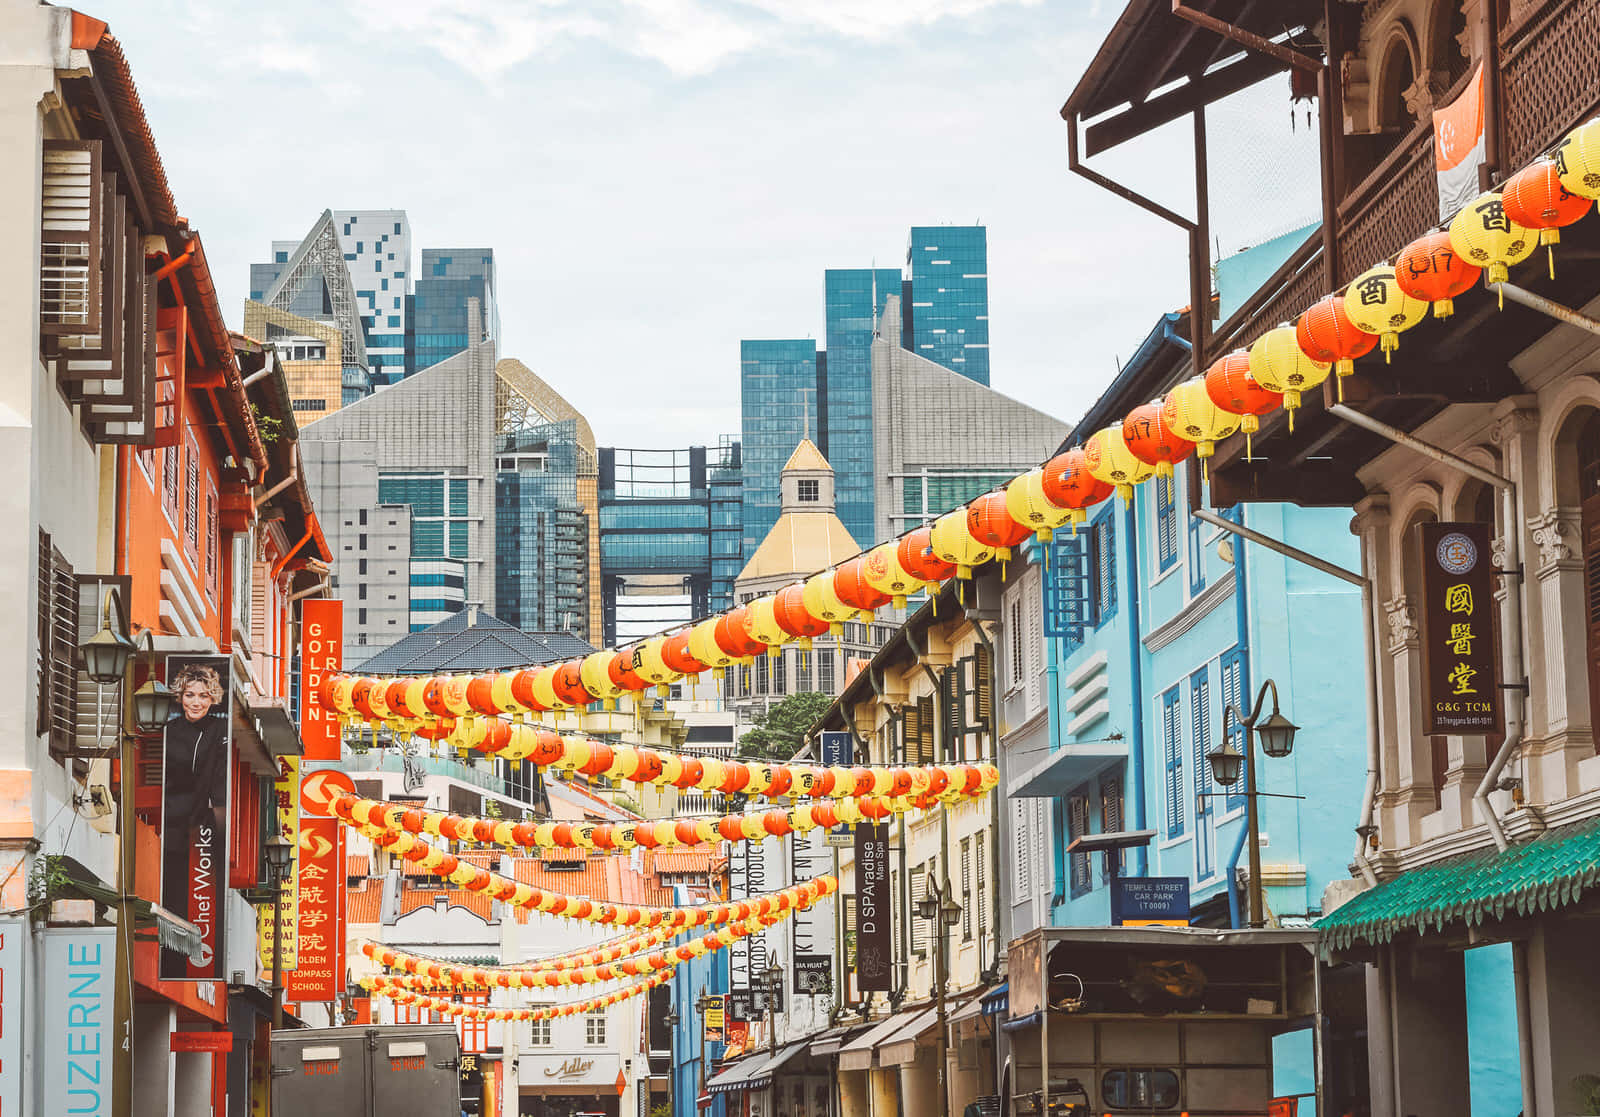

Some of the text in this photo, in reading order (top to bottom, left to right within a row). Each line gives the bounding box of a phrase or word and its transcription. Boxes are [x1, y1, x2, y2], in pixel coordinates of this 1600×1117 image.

[1445, 584, 1477, 694] 國醫堂
[308, 623, 321, 721] GOLDEN
[325, 640, 337, 738] TREL
[1436, 702, 1491, 712] G&G TCM
[876, 841, 885, 880] Man Spa
[1124, 883, 1184, 892] TEMPLE STREET
[269, 903, 292, 911] SOP
[862, 922, 875, 933] D
[298, 956, 327, 964] OLDEN
[292, 969, 332, 978] COMPASS
[292, 982, 326, 991] SCHOOL
[67, 943, 101, 1117] UZERNE
[544, 1056, 595, 1078] Adler
